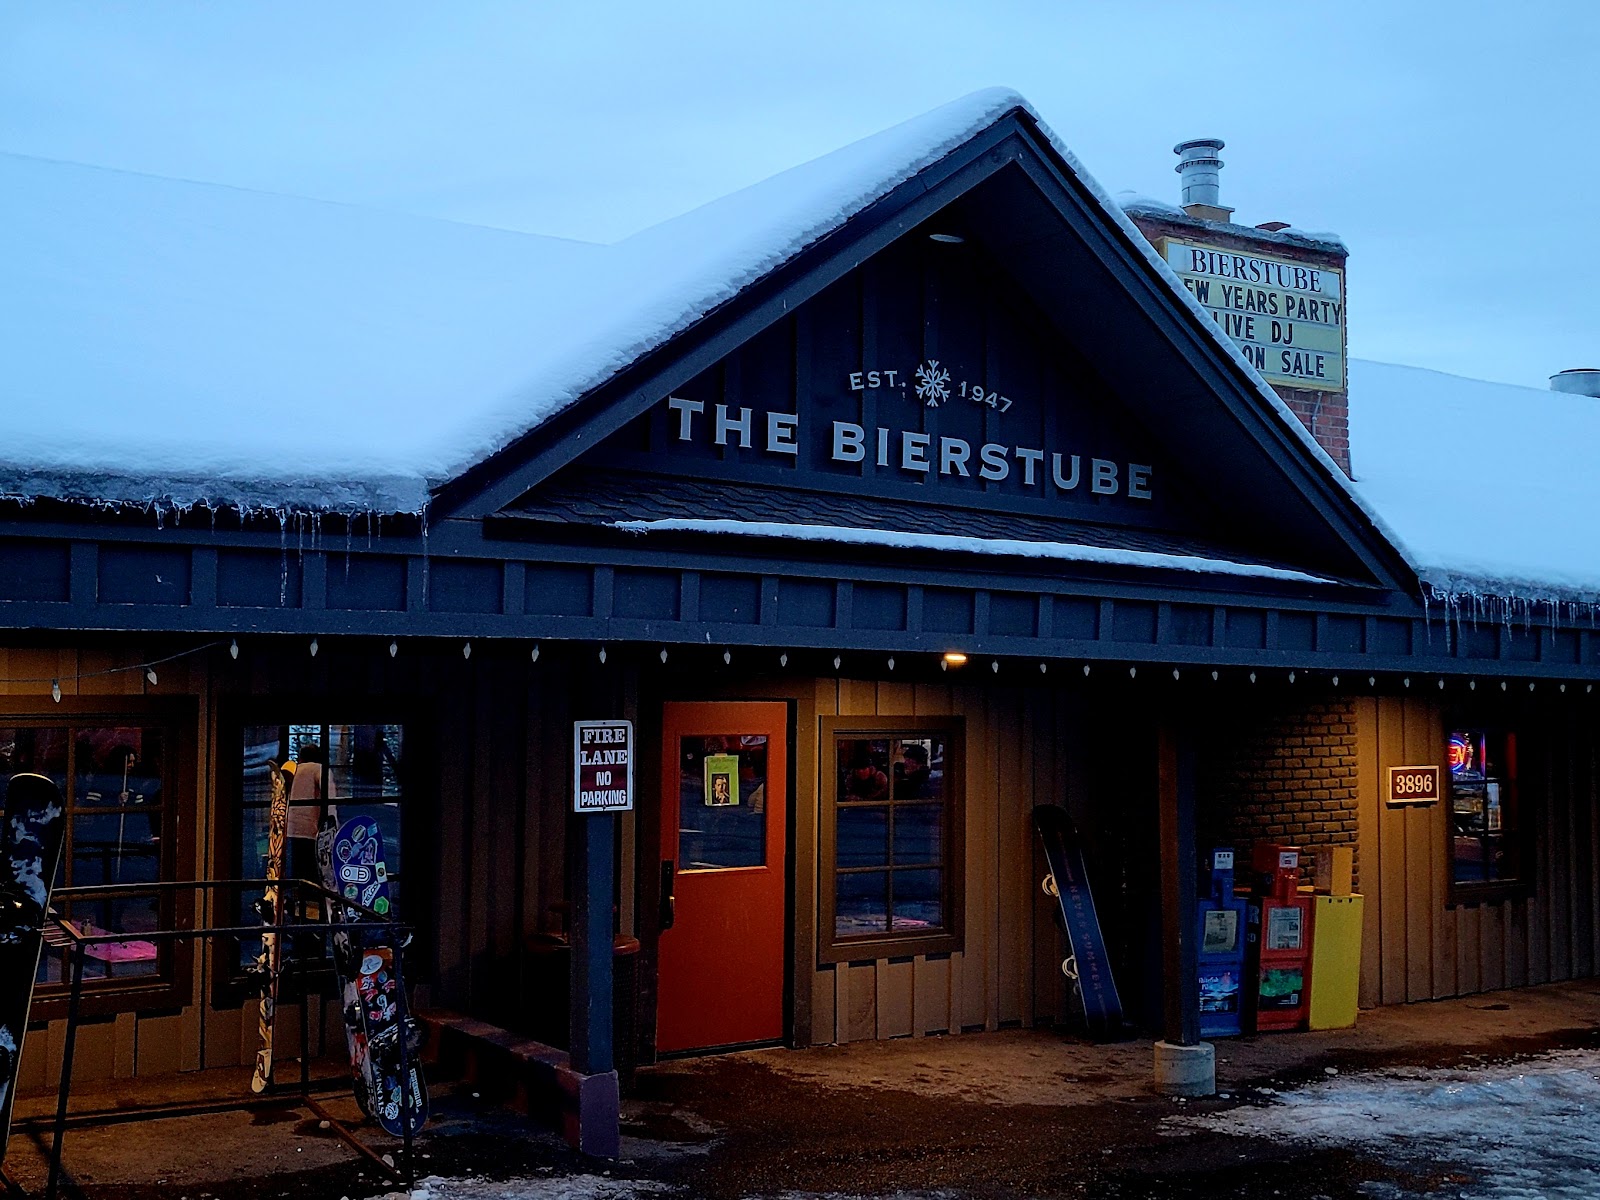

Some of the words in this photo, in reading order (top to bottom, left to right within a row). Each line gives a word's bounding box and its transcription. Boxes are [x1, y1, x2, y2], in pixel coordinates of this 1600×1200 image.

[1190, 249, 1322, 293] BIERSTUBE
[1183, 278, 1210, 304] EW
[1221, 284, 1279, 315] YEARS
[1285, 294, 1342, 325] PARTY
[1271, 320, 1294, 345] DJ
[1241, 344, 1266, 370] ON
[1281, 350, 1325, 378] SALE
[849, 370, 907, 391] EST.
[958, 380, 1013, 413] 1947
[668, 396, 798, 456] THE
[831, 420, 1153, 500] BIERSTUBE
[582, 728, 626, 745] FIRE
[580, 750, 628, 766] LANE
[595, 770, 612, 787] NO
[1395, 774, 1433, 794] 3896
[580, 789, 627, 807] PARKING
